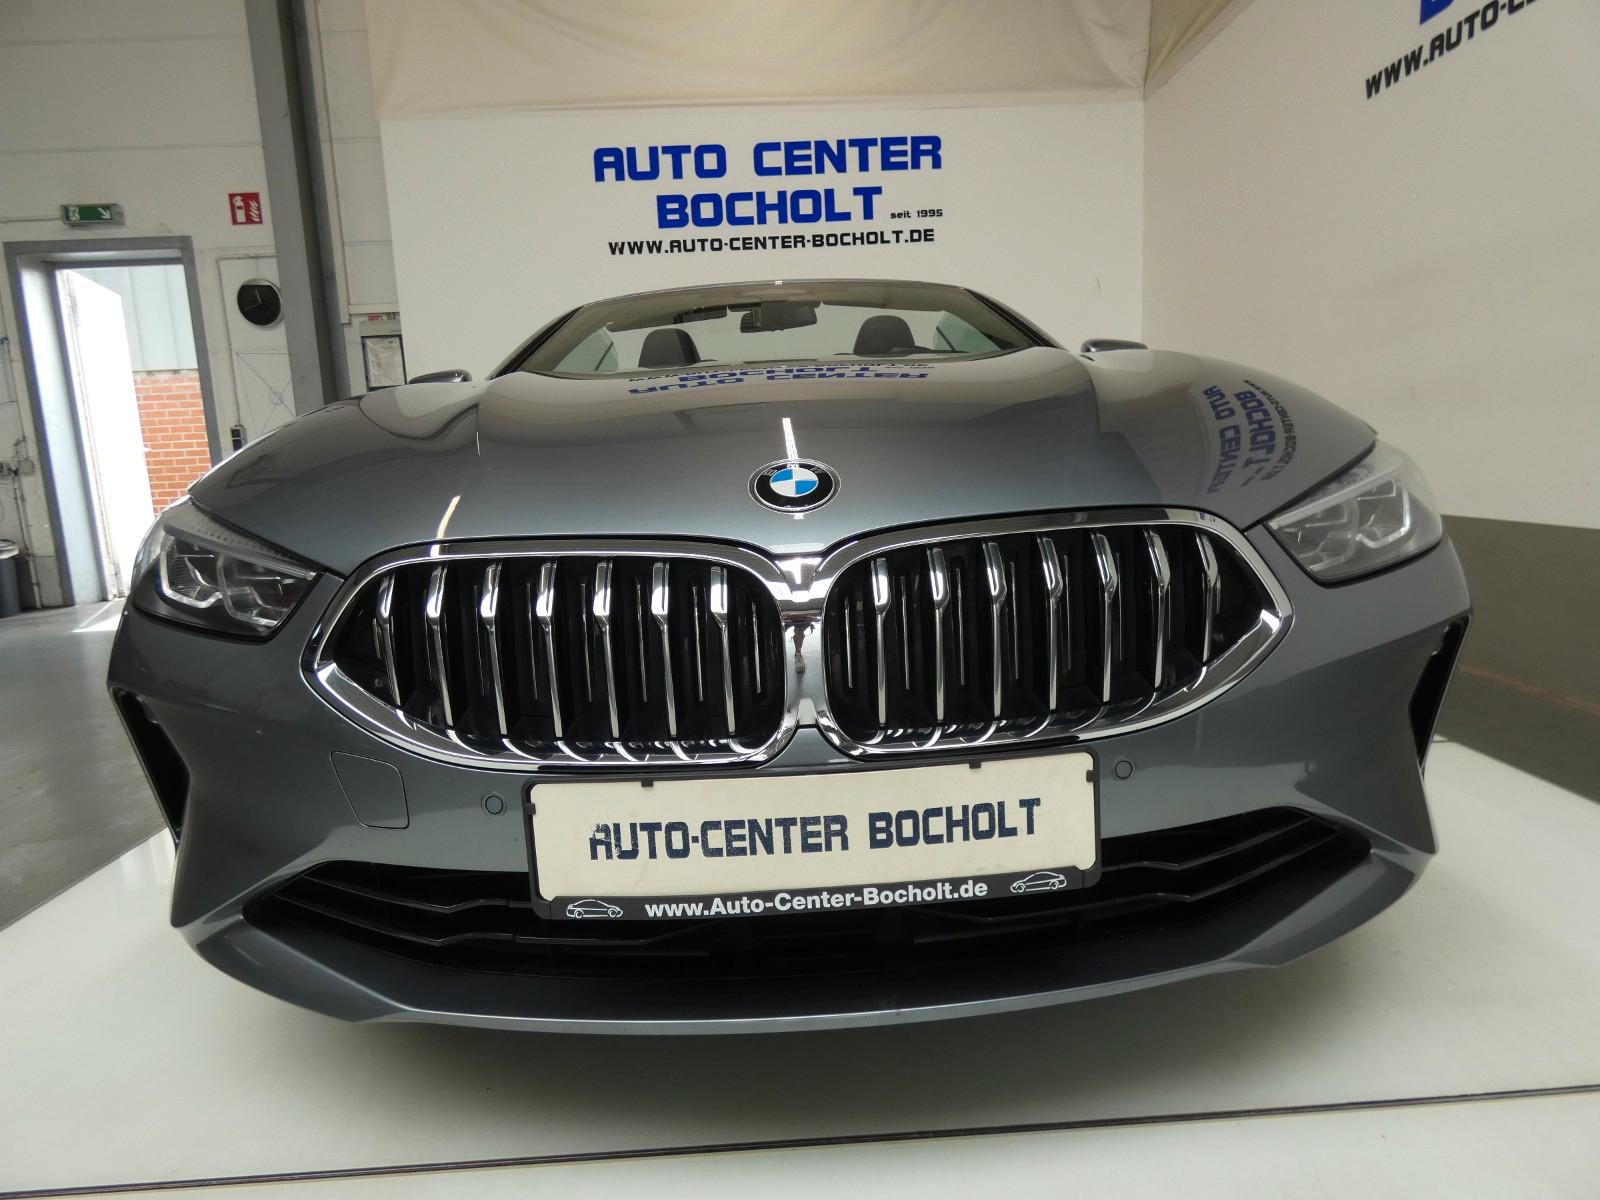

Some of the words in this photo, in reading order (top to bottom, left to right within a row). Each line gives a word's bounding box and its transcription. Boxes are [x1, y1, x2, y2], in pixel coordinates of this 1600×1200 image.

[1365, 0, 1537, 100] WWW.AUTO-
[593, 144, 727, 182] AUTO
[753, 135, 942, 177] CENTER
[656, 186, 883, 229] BOCHOLT
[890, 210, 911, 219] seit
[917, 209, 943, 218] 1995
[608, 228, 935, 255] WWW.AUTO-CENTER-BOCHOLT.DE
[588, 813, 849, 861] AUTO-CENTER
[868, 797, 1042, 850] BOCHOLT
[644, 881, 989, 919] www.Auto-Center-Bocholt.de
